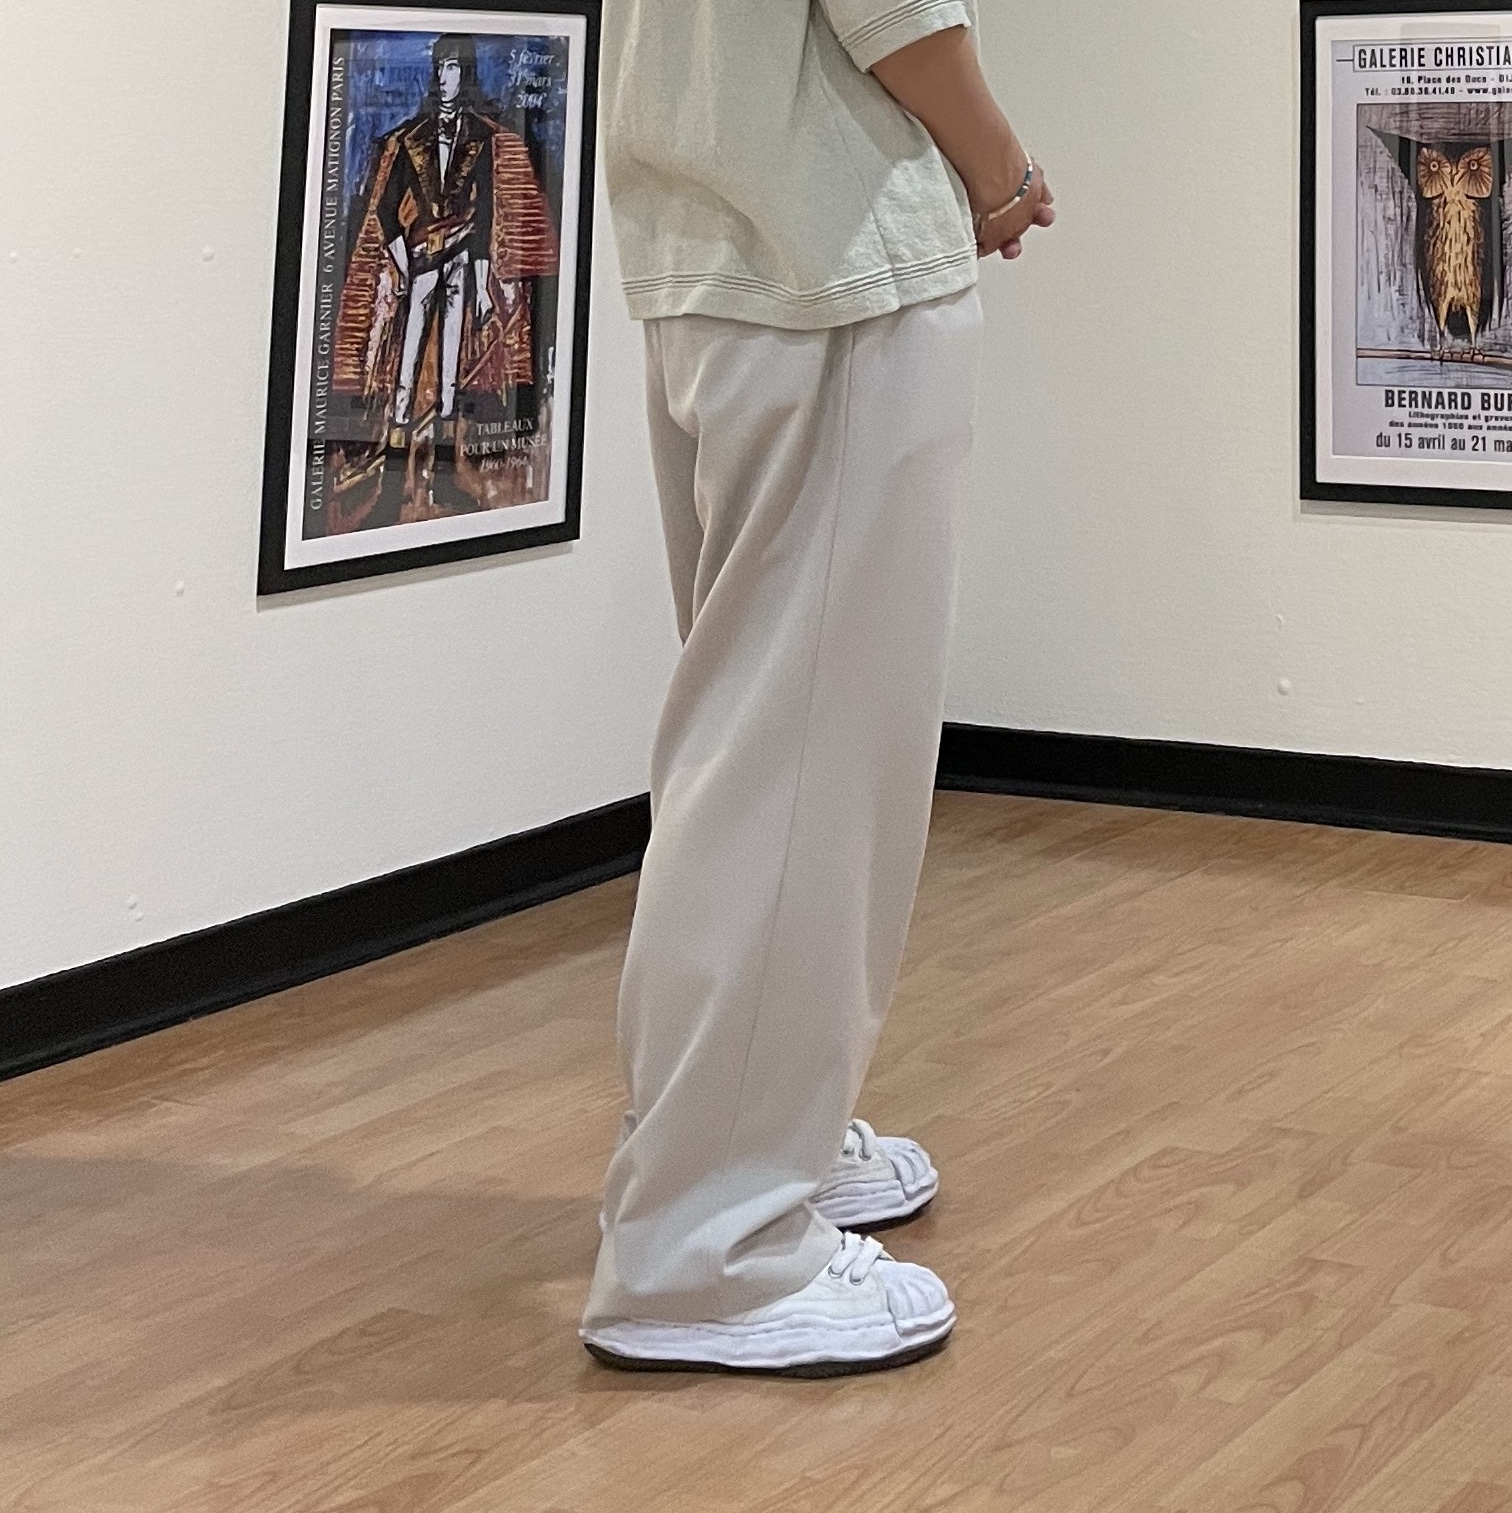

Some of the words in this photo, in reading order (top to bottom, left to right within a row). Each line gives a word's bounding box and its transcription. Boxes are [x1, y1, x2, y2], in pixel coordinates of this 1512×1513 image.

[1358, 47, 1426, 69] GALERIE
[332, 56, 344, 101] PARIS
[1418, 76, 1442, 84] Place
[326, 107, 342, 192] MATIGNON
[324, 196, 338, 260] AVENUE
[322, 264, 333, 273] 6
[318, 282, 334, 354] GARNIER
[314, 358, 329, 434] MAURICE
[1384, 389, 1472, 410] BERNARD
[476, 418, 534, 436] TABLEAUX
[460, 441, 490, 456] POUR
[1376, 432, 1390, 448] du
[1398, 433, 1412, 448] 15
[1418, 434, 1446, 450] avril
[1450, 438, 1465, 450] au
[1471, 435, 1486, 452] 21
[310, 440, 326, 510] GALERIE
